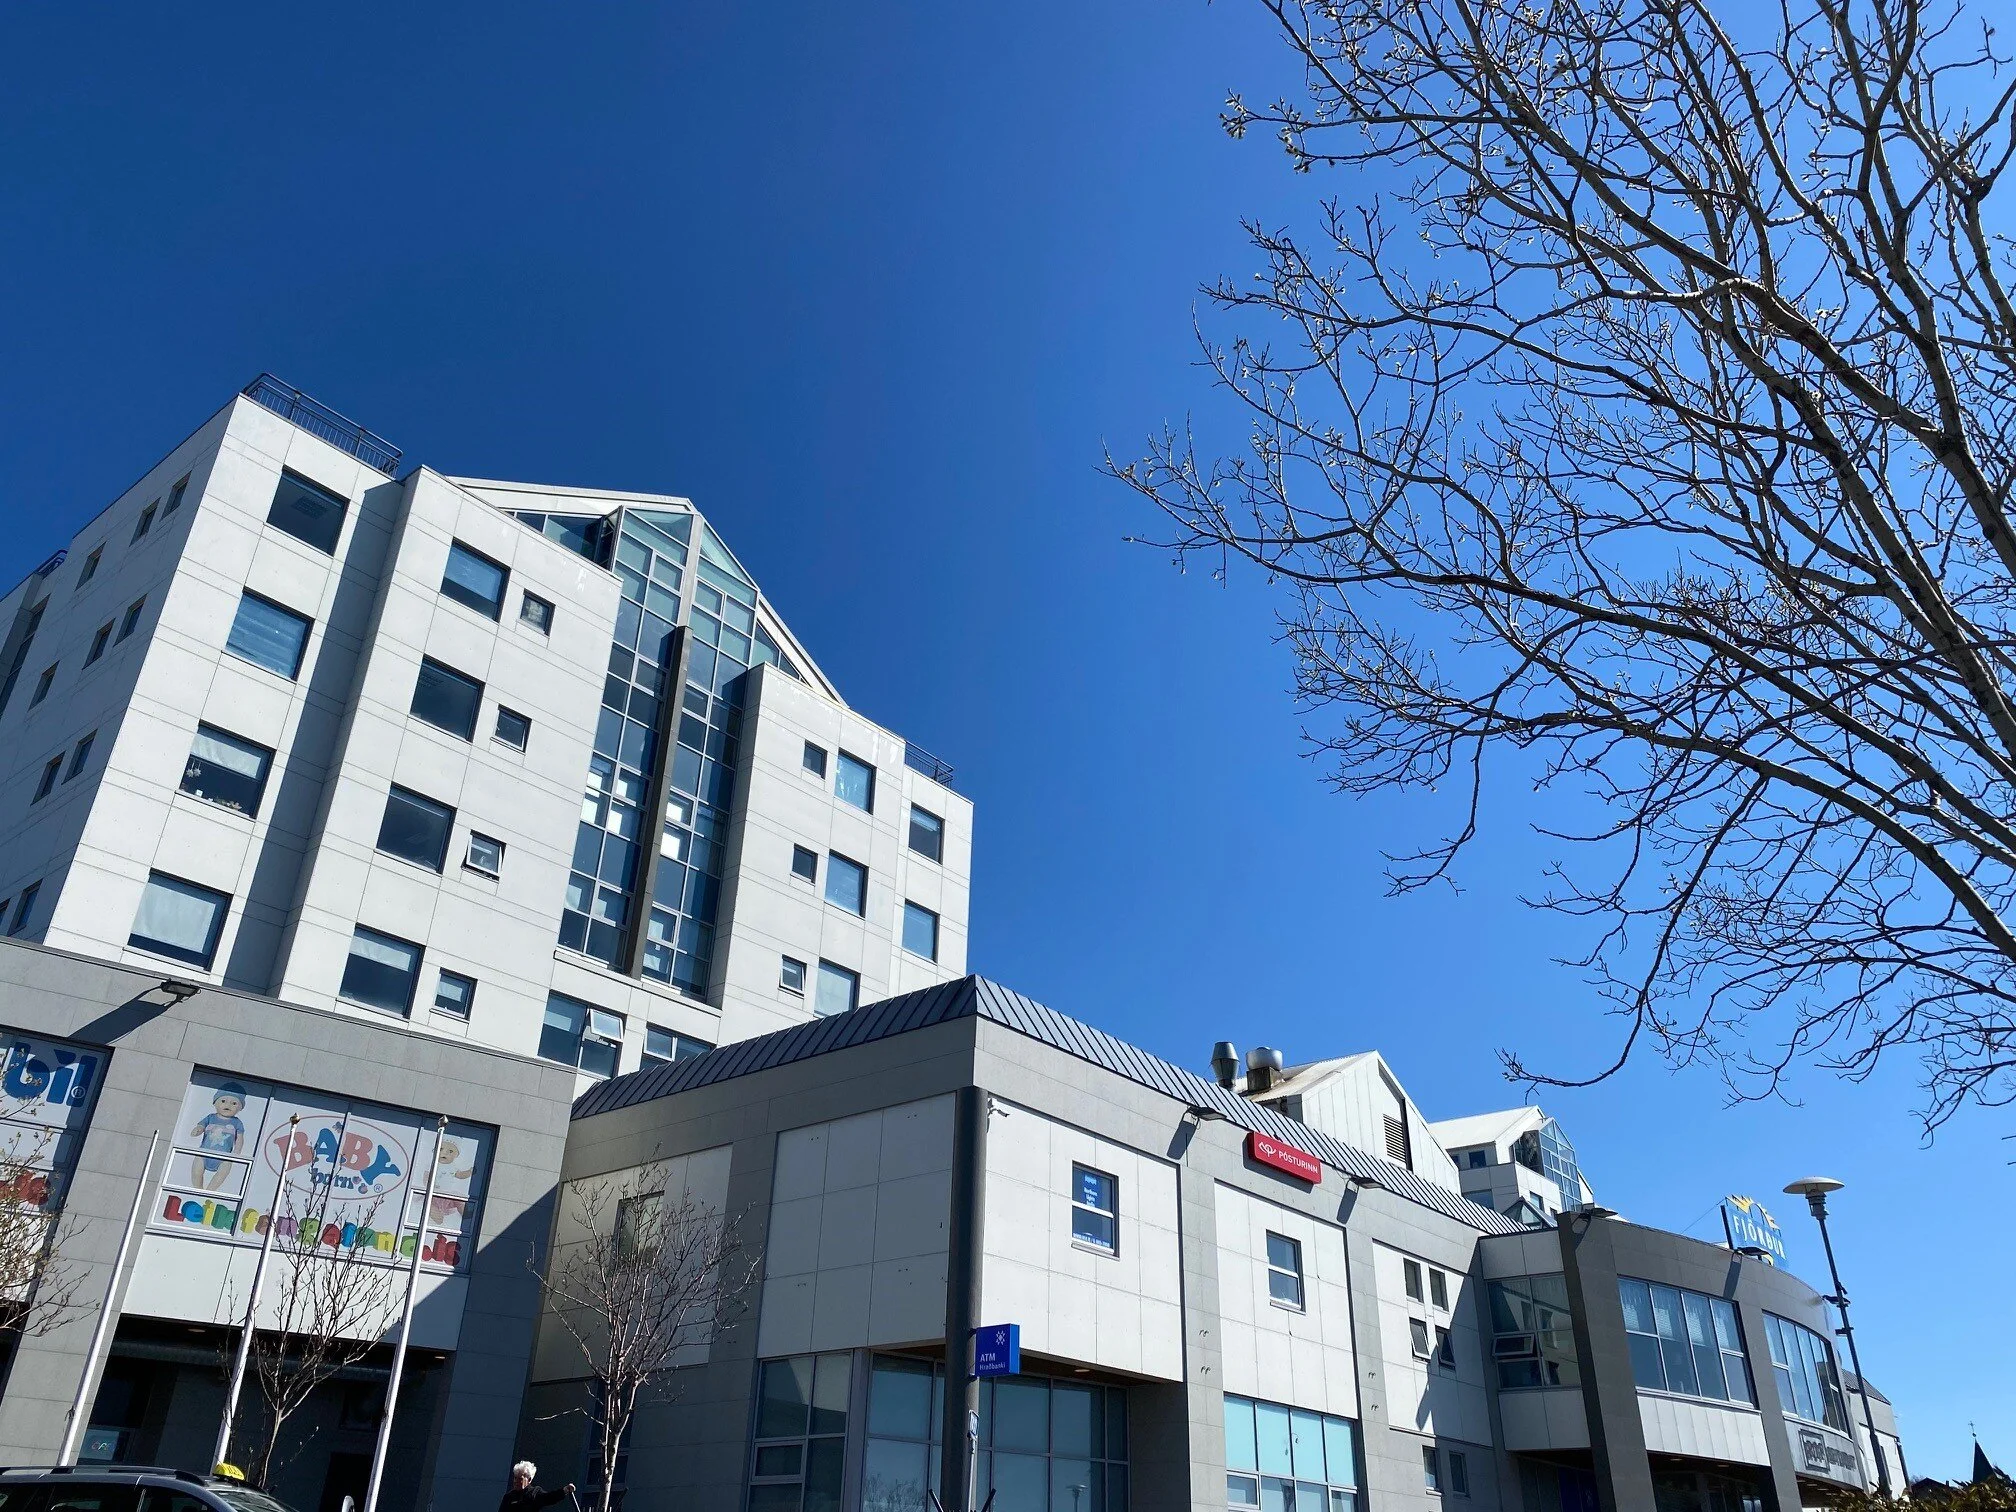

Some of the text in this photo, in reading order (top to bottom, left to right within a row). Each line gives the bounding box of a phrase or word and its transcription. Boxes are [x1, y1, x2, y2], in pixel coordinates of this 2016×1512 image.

[273, 1127, 401, 1185] BABY
[1278, 1149, 1318, 1174] PÓSTURINN
[309, 1167, 354, 1190] born
[980, 1352, 996, 1363] ATM
